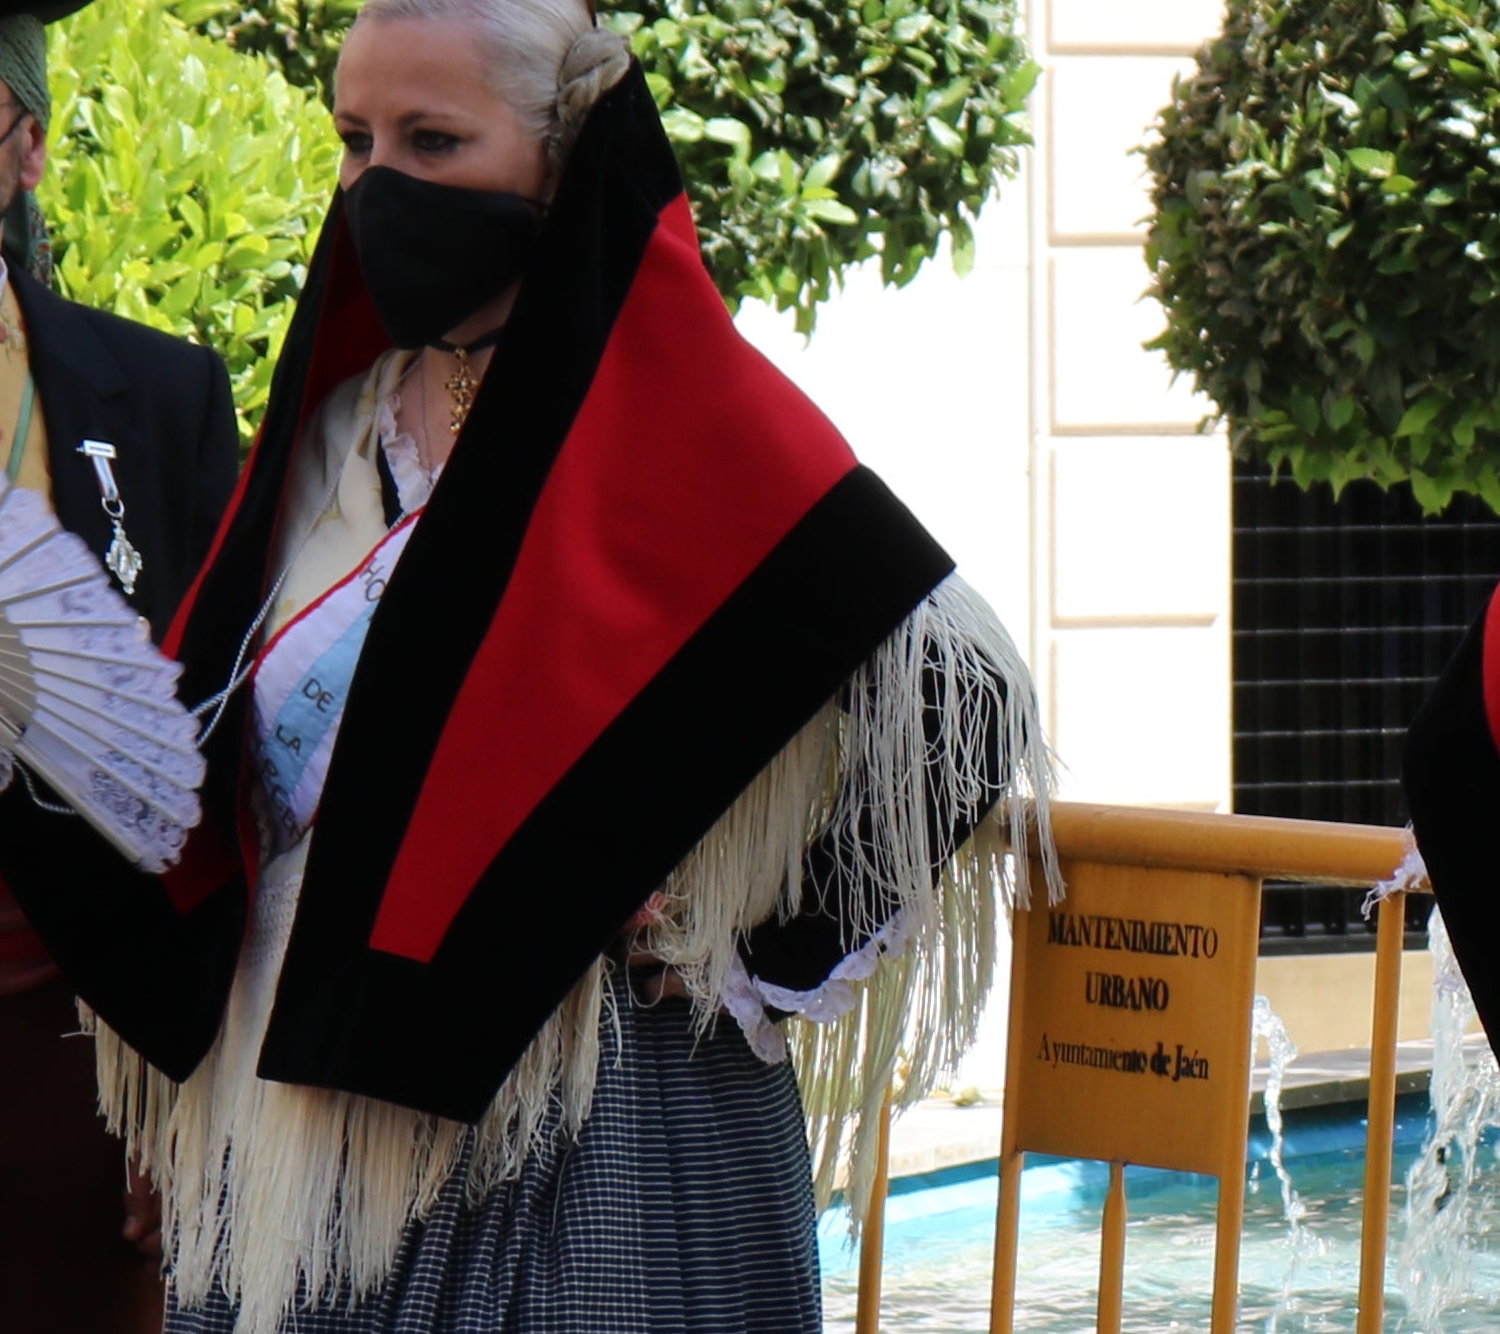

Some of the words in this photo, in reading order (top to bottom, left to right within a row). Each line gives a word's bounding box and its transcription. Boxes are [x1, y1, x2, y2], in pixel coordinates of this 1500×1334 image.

[359, 557, 386, 605] HO
[302, 677, 335, 714] DE
[276, 724, 301, 756] LA
[1047, 911, 1219, 959] MANTENIMIENTO
[1085, 971, 1170, 1011] URBANO
[1037, 1032, 1148, 1074] Ayuntamiento
[1150, 1040, 1171, 1077] de
[1171, 1044, 1210, 1082] Jaén
